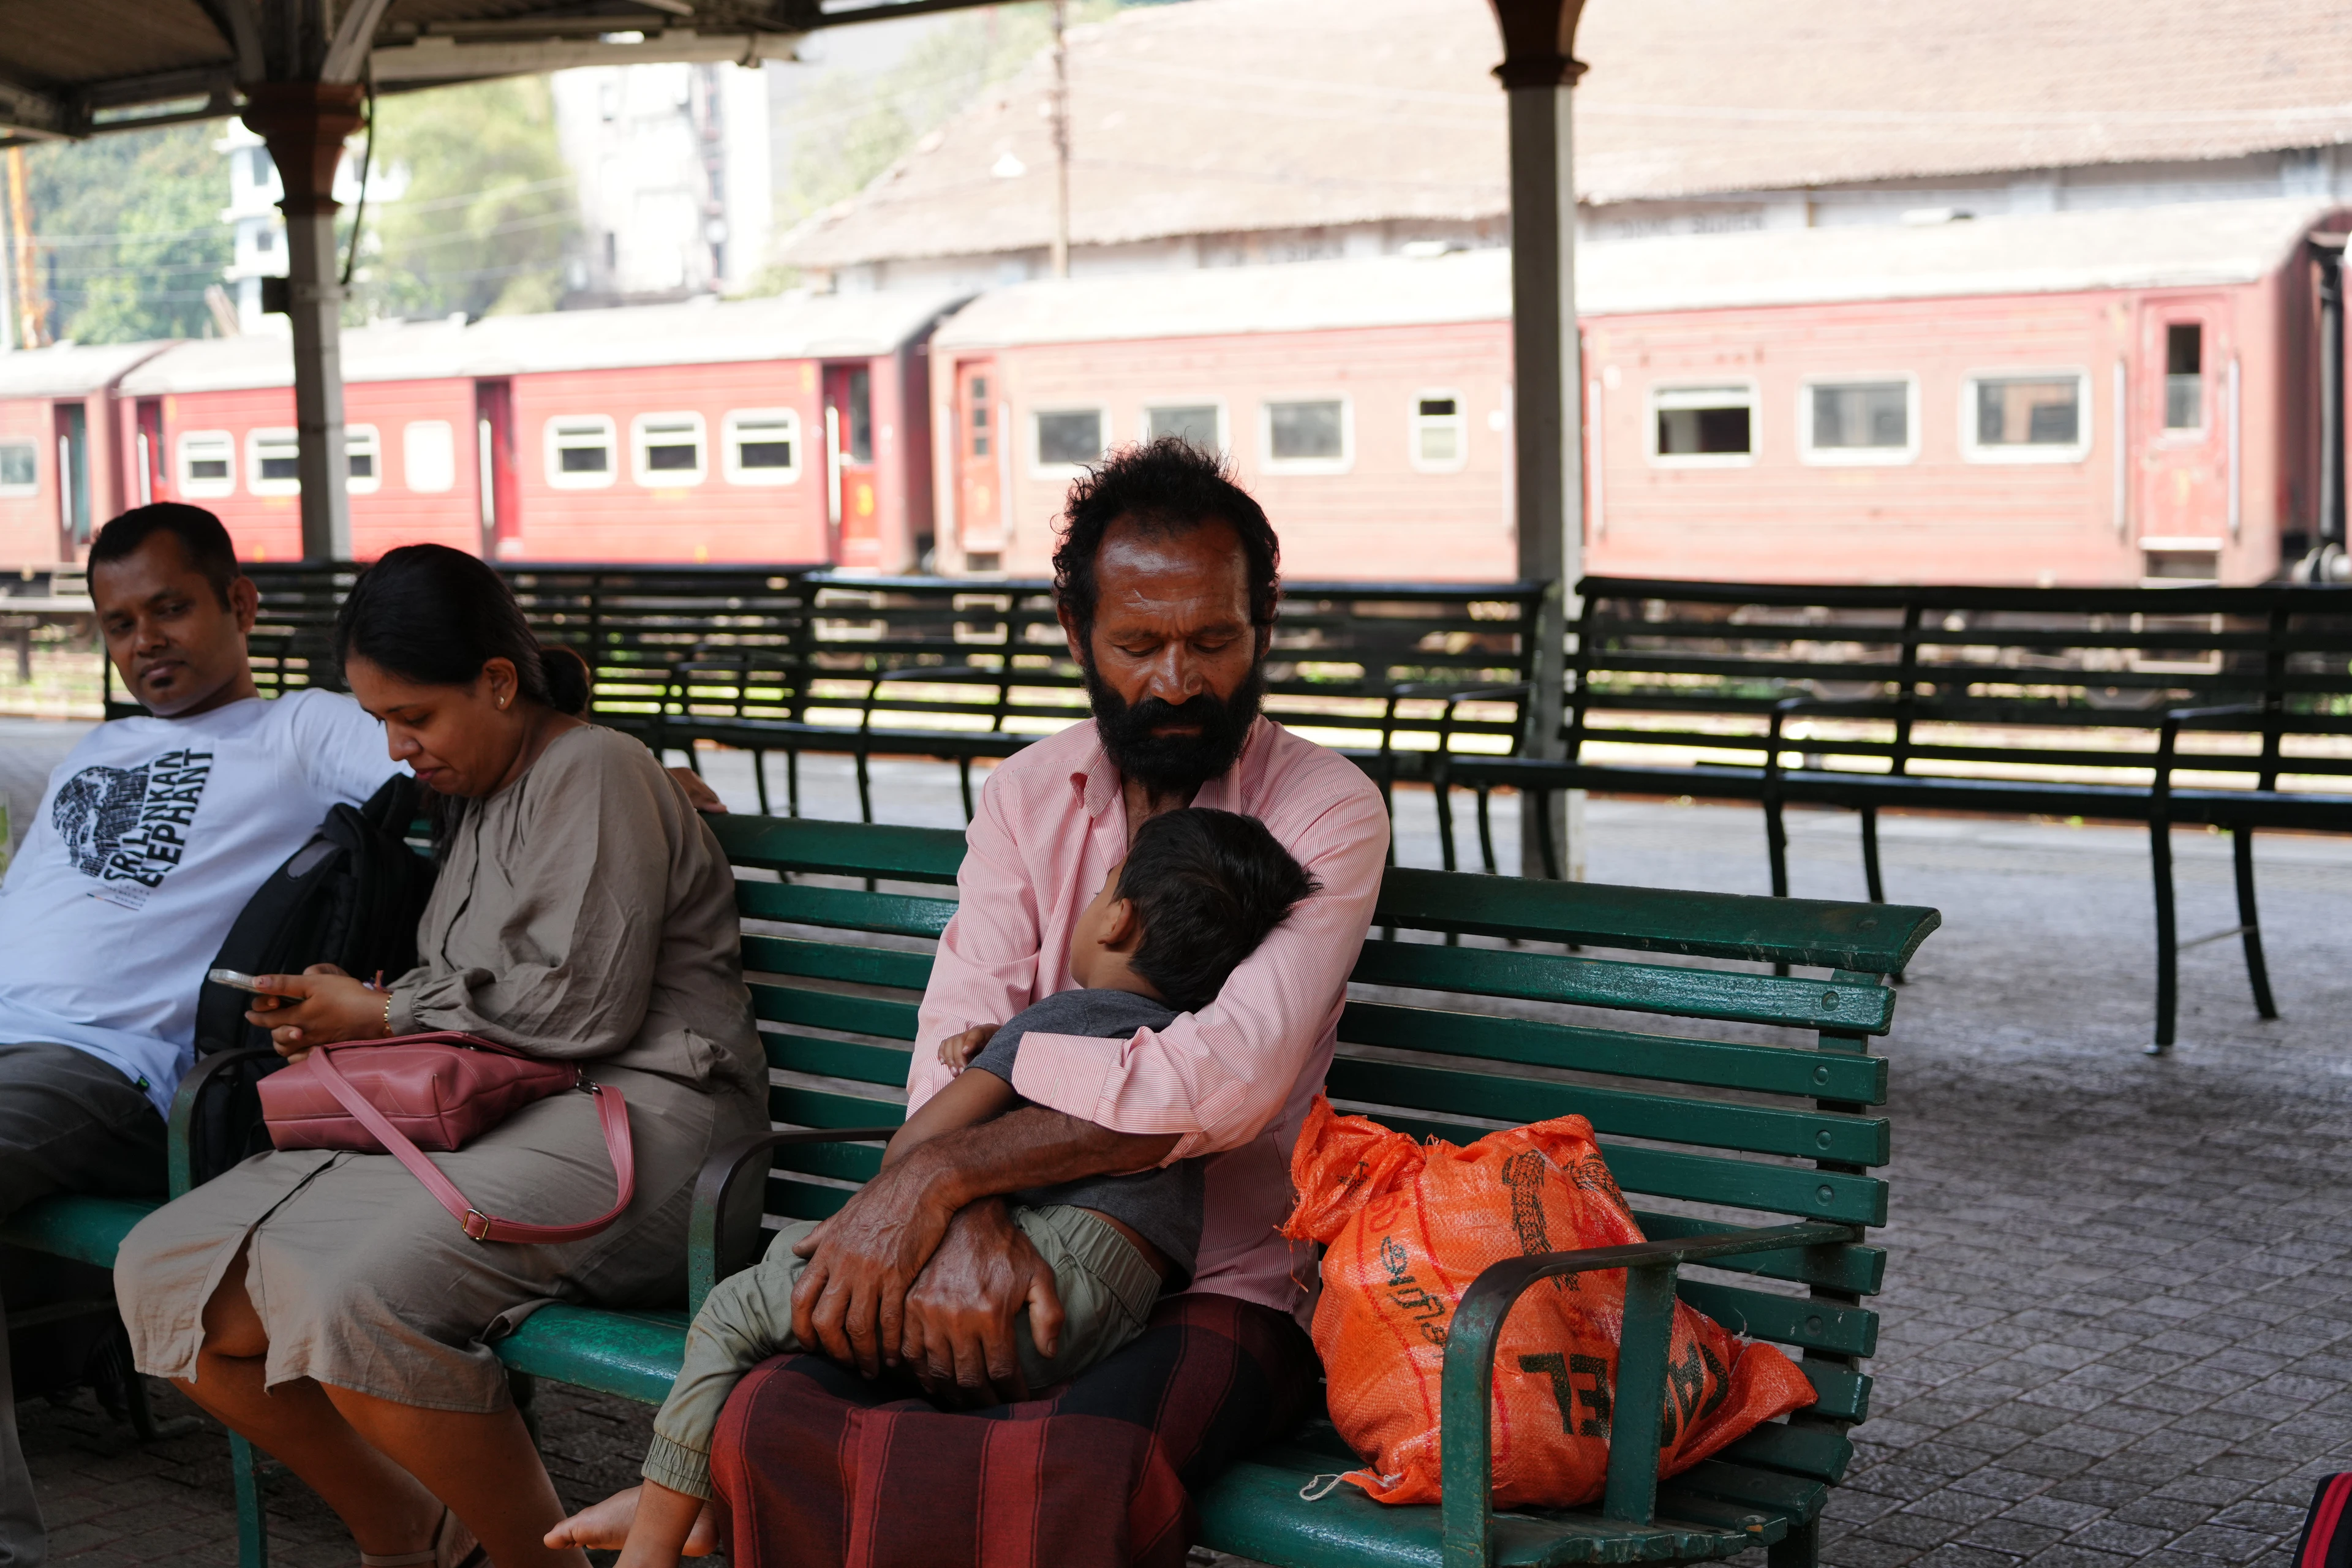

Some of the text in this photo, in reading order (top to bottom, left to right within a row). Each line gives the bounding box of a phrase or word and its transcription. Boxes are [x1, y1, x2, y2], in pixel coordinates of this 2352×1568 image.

[104, 849, 146, 880] SRI
[134, 747, 213, 888] ELEPHANT
[1517, 1340, 1729, 1448] CAEL
